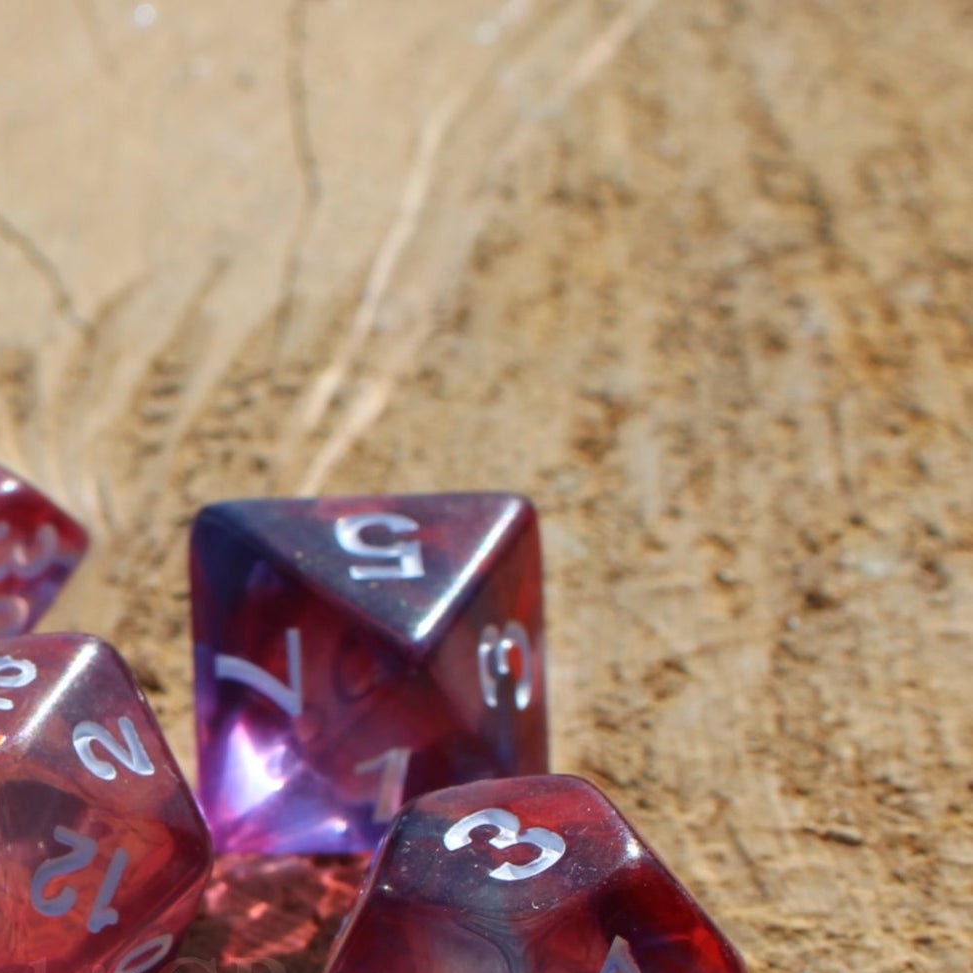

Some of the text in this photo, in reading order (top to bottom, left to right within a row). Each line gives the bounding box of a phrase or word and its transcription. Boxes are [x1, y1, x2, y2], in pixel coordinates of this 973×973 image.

[335, 512, 425, 580] 5
[214, 627, 302, 717] 7
[72, 716, 154, 781] 2
[30, 825, 129, 934] 12
[444, 808, 566, 882] 3
